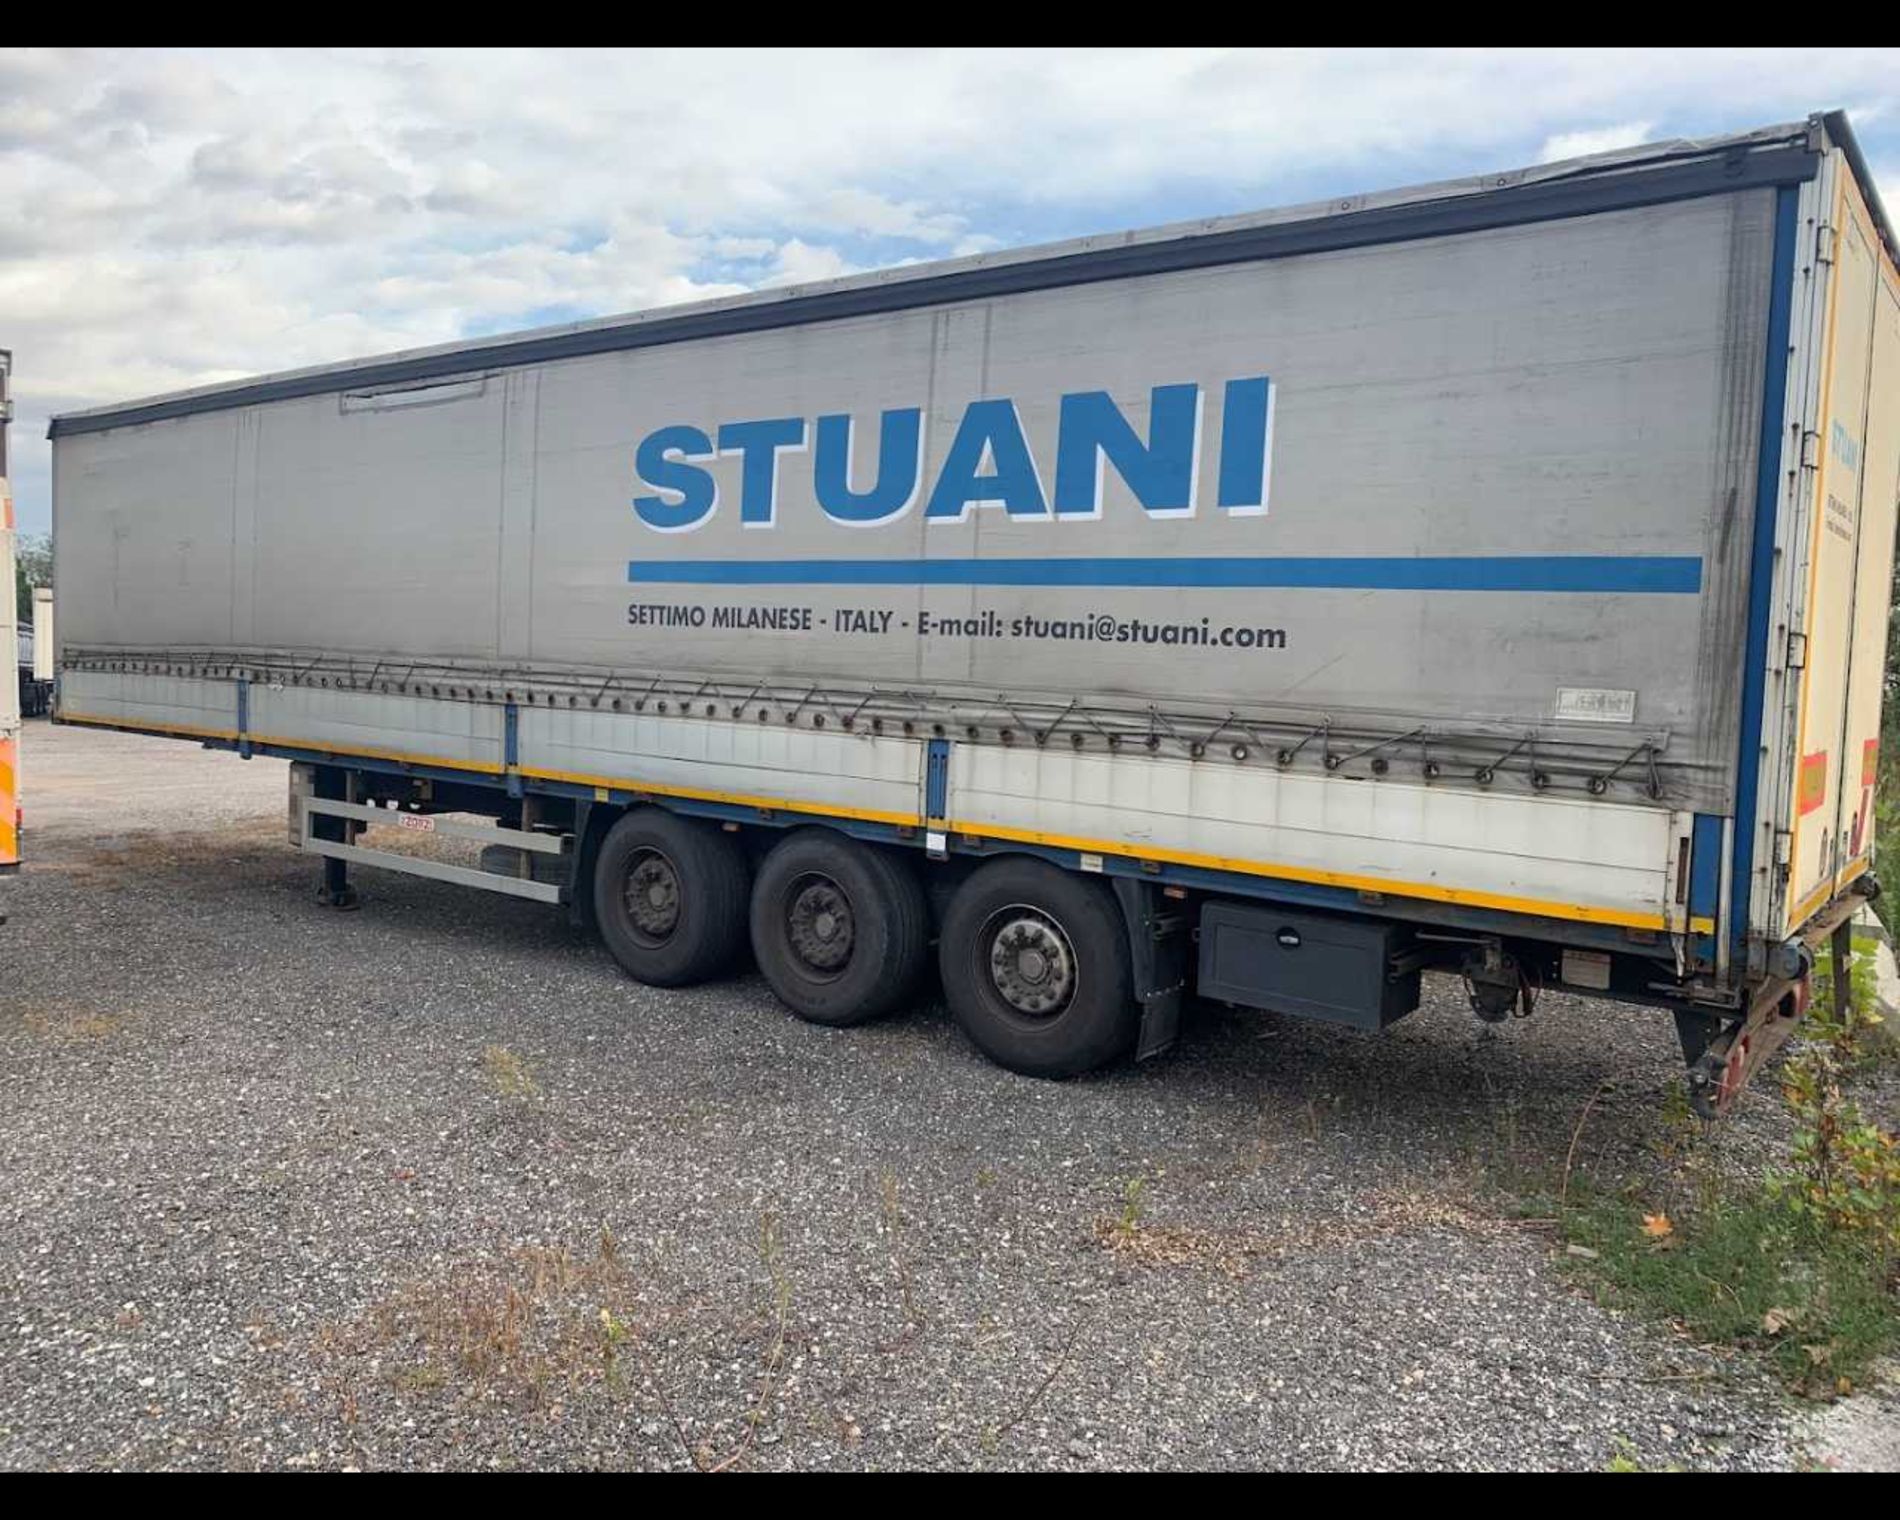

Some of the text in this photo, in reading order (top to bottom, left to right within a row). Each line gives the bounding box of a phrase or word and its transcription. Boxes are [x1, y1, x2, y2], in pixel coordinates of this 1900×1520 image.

[632, 376, 1276, 533] STUANI
[628, 604, 706, 627] SETTIMO
[712, 607, 812, 630] MILANESE
[835, 609, 894, 633] ITALY
[918, 611, 1003, 638] E-mail:
[1011, 613, 1286, 648] stuani@stuani.com
